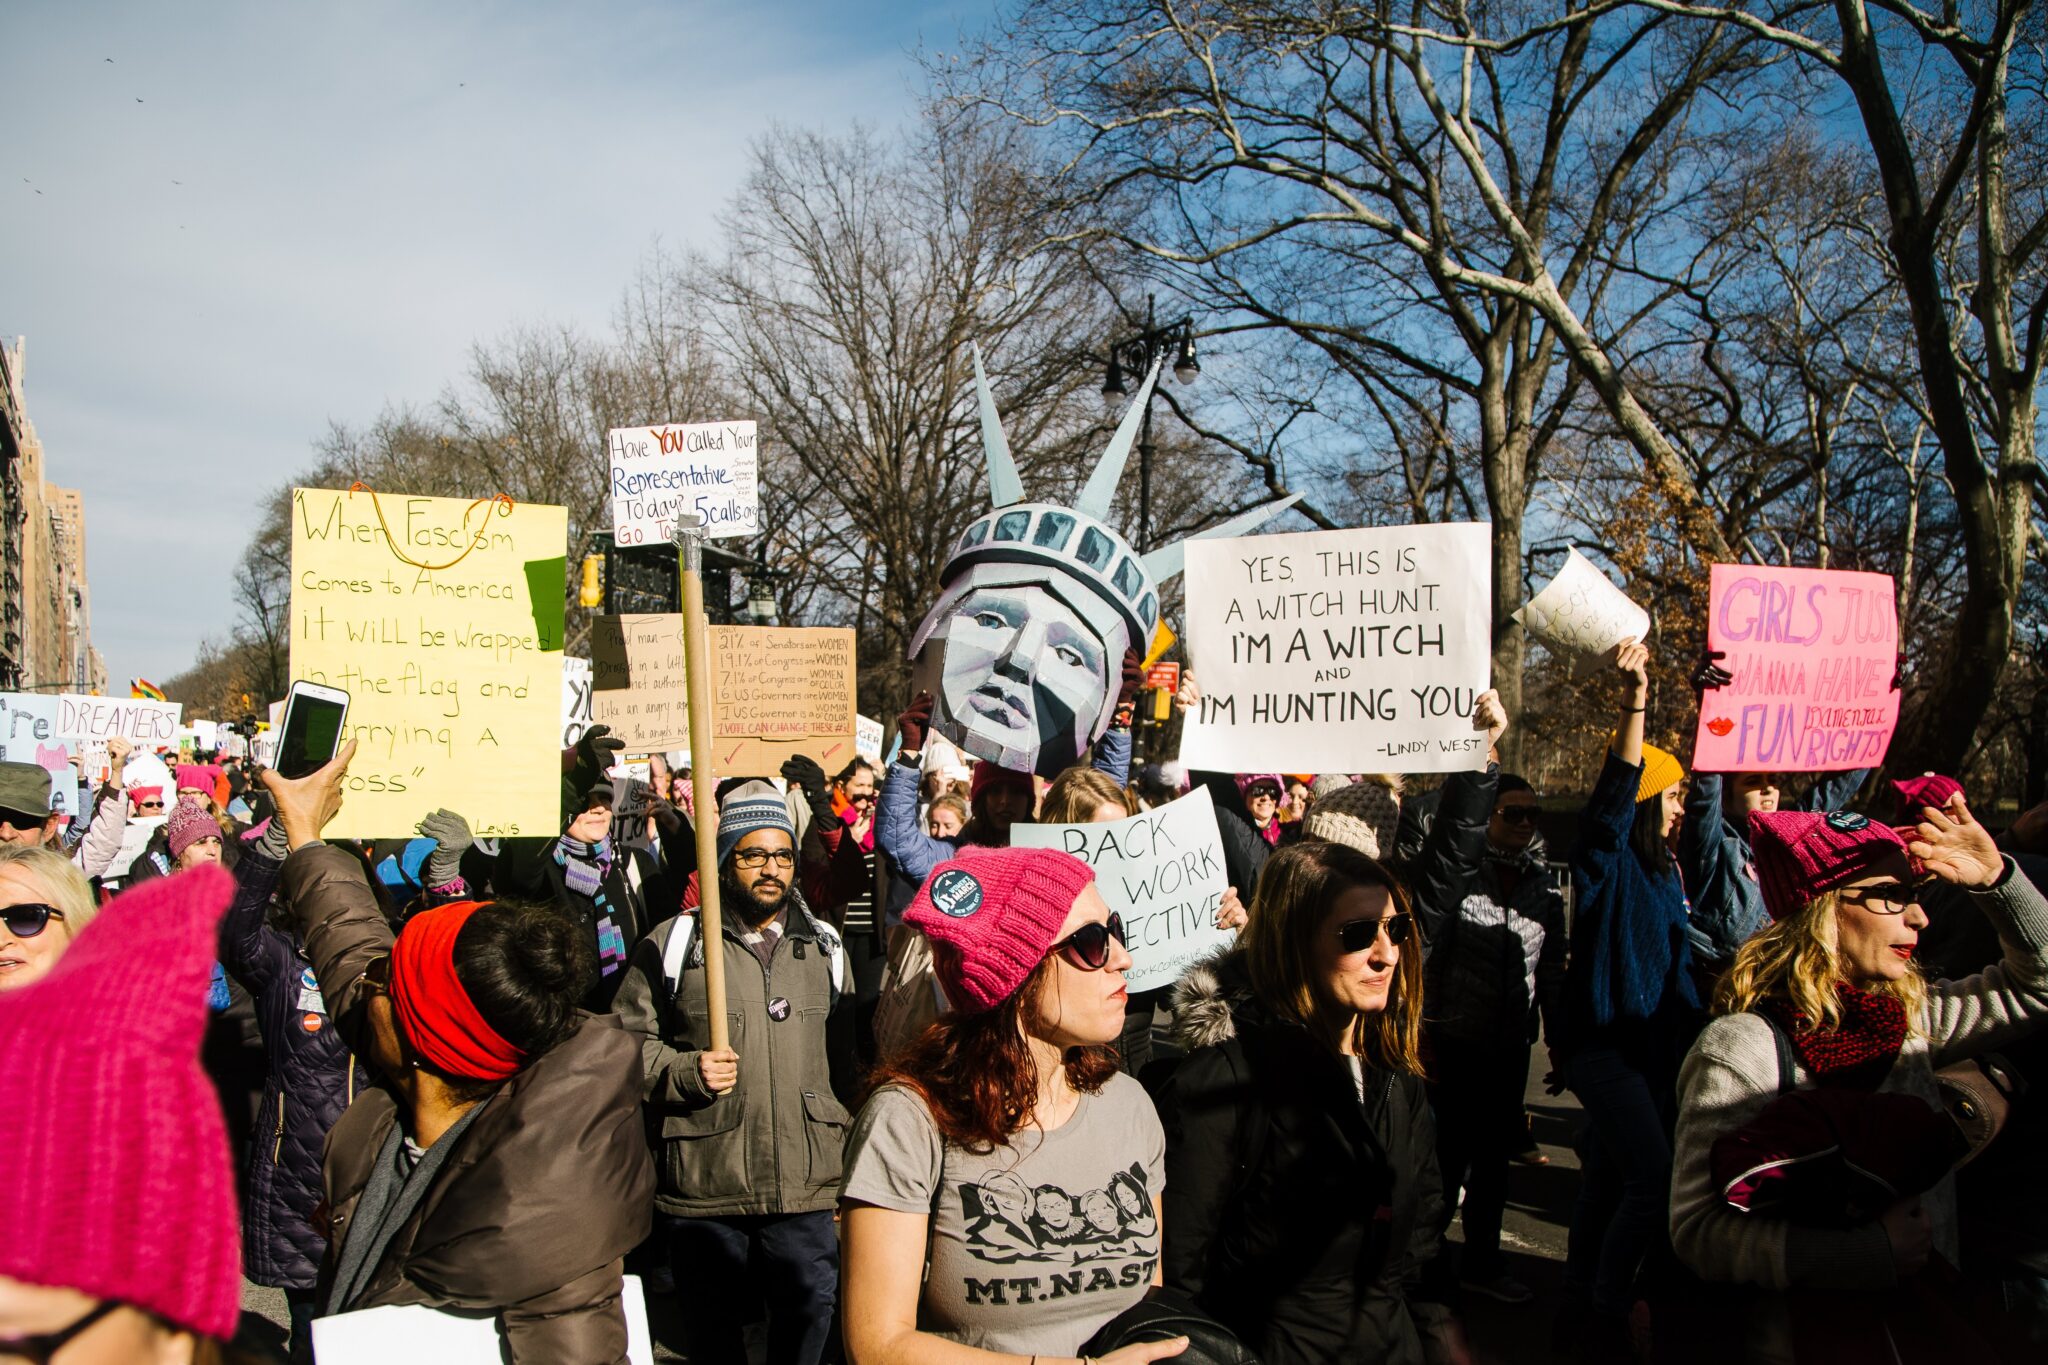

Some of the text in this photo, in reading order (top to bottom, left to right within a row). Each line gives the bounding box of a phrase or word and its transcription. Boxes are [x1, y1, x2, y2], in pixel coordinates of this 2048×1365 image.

[611, 434, 650, 460] Have
[651, 427, 684, 456] YOU
[727, 426, 757, 450] Your
[612, 465, 733, 501] Representative
[407, 499, 514, 552] Fascism
[618, 525, 643, 545] Go
[380, 569, 402, 595] to
[411, 560, 514, 601] America
[1241, 547, 1416, 583] YES, THIS IS
[1225, 584, 1441, 624] A WITCH HUNT.
[1718, 577, 1896, 647] GIRLS JUST
[420, 616, 447, 649] be
[719, 634, 744, 650] 21%
[765, 635, 804, 649] Senators
[817, 639, 849, 651] WOMEN
[1232, 624, 1445, 664] I'M A WITCH
[764, 654, 804, 671] Congress
[816, 652, 848, 666] WOMEN
[809, 669, 844, 680] WOMEN
[1314, 667, 1352, 684] AND
[1728, 653, 1888, 702] WANNA HAVE
[337, 664, 392, 697] the
[480, 675, 530, 699] and
[721, 687, 730, 700] 6
[734, 689, 749, 701] US
[751, 688, 802, 701] Governors
[818, 691, 849, 701] WOMEN
[820, 681, 846, 690] COLOR
[63, 699, 177, 740] DREAMERS
[601, 701, 620, 719] Like
[734, 705, 748, 720] US
[749, 706, 798, 719] Governor
[1200, 694, 1236, 726] I'M
[1252, 688, 1397, 724] HUNTING
[724, 723, 745, 735] VOTE
[747, 723, 769, 734] CAN
[770, 722, 809, 733] CHANGE
[1439, 738, 1482, 753] WEST
[1736, 703, 1810, 765] FUN
[1804, 728, 1889, 768] RIGHTS
[475, 819, 521, 836] Lewis
[1064, 812, 1176, 865] BACK
[1122, 843, 1220, 905] WORK
[1124, 892, 1222, 953] ECTIVE
